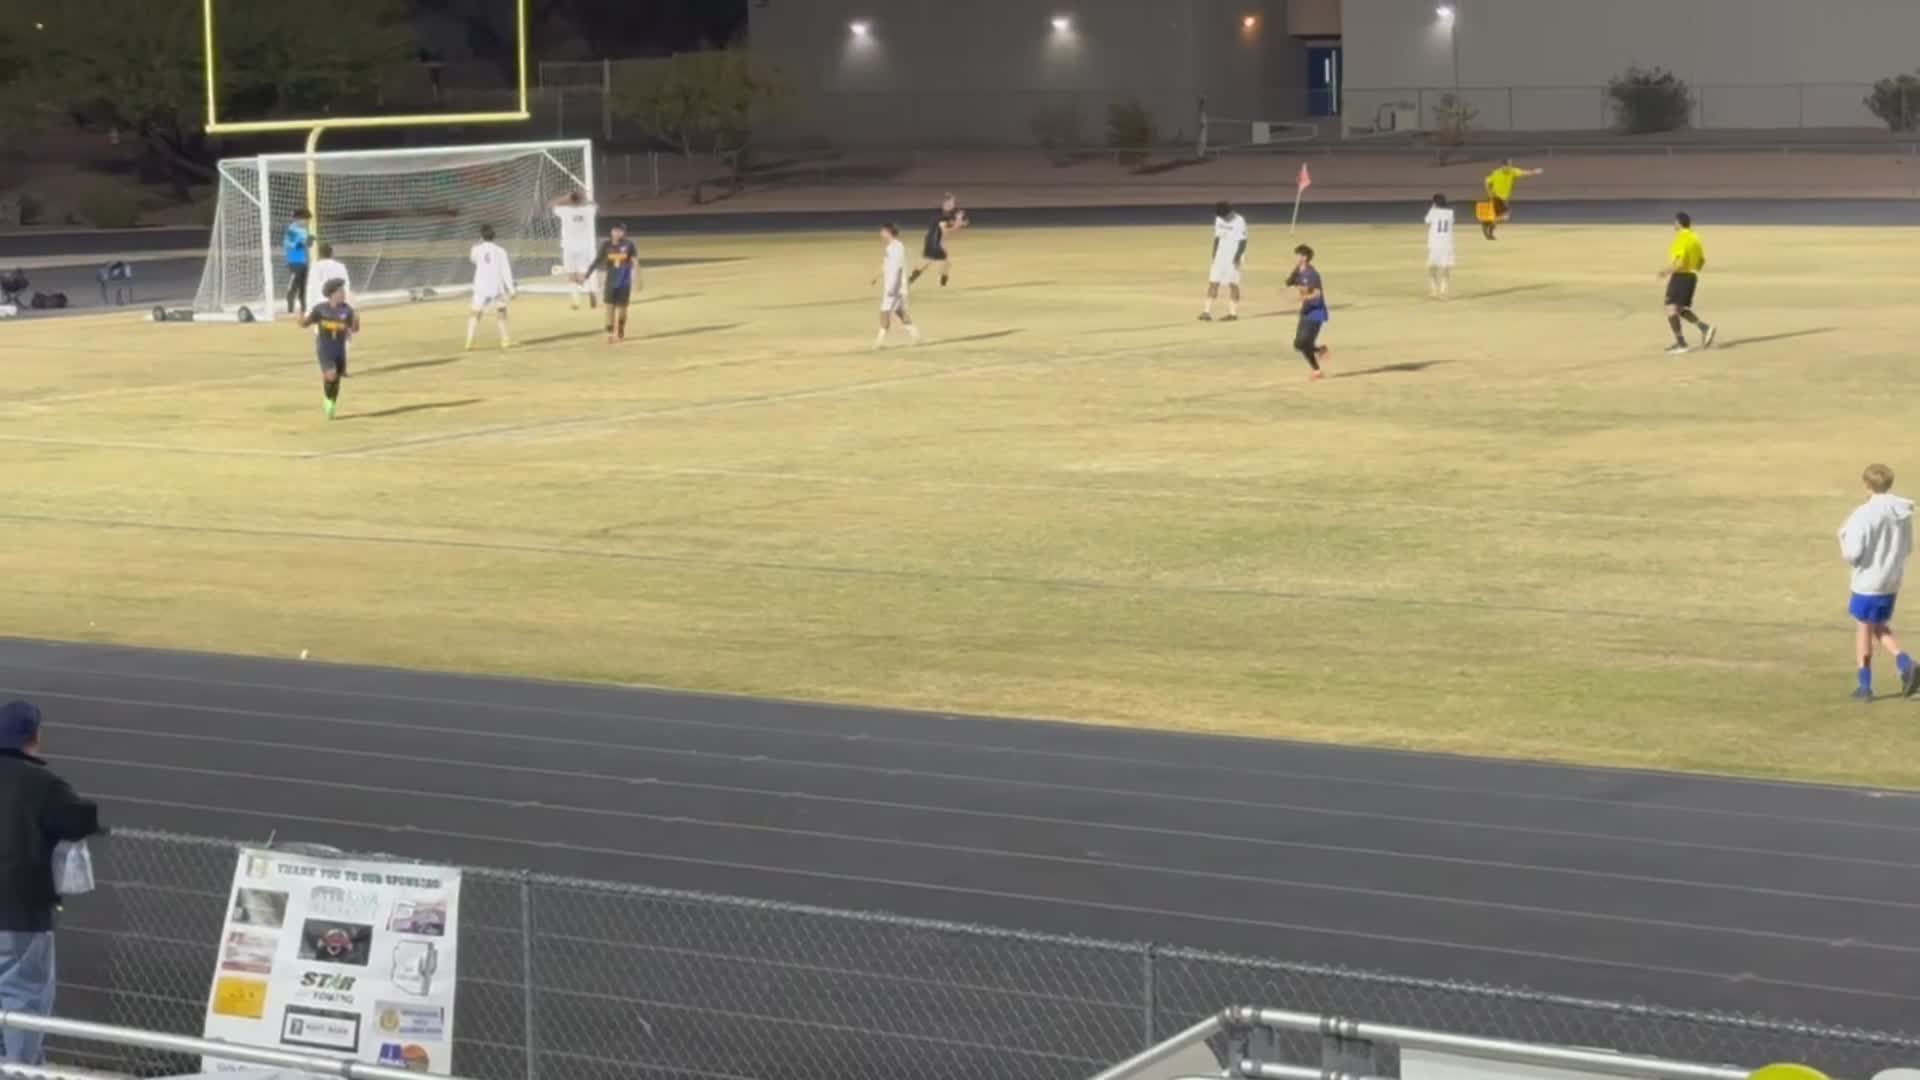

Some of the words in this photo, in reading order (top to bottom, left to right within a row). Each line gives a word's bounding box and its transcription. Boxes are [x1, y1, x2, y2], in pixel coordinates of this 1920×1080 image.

[1437, 219, 1449, 233] 11
[277, 863, 316, 878] THANK
[320, 868, 342, 880] YOU
[345, 871, 359, 882] TO
[361, 872, 384, 885] OUR
[300, 971, 357, 991] STAR
